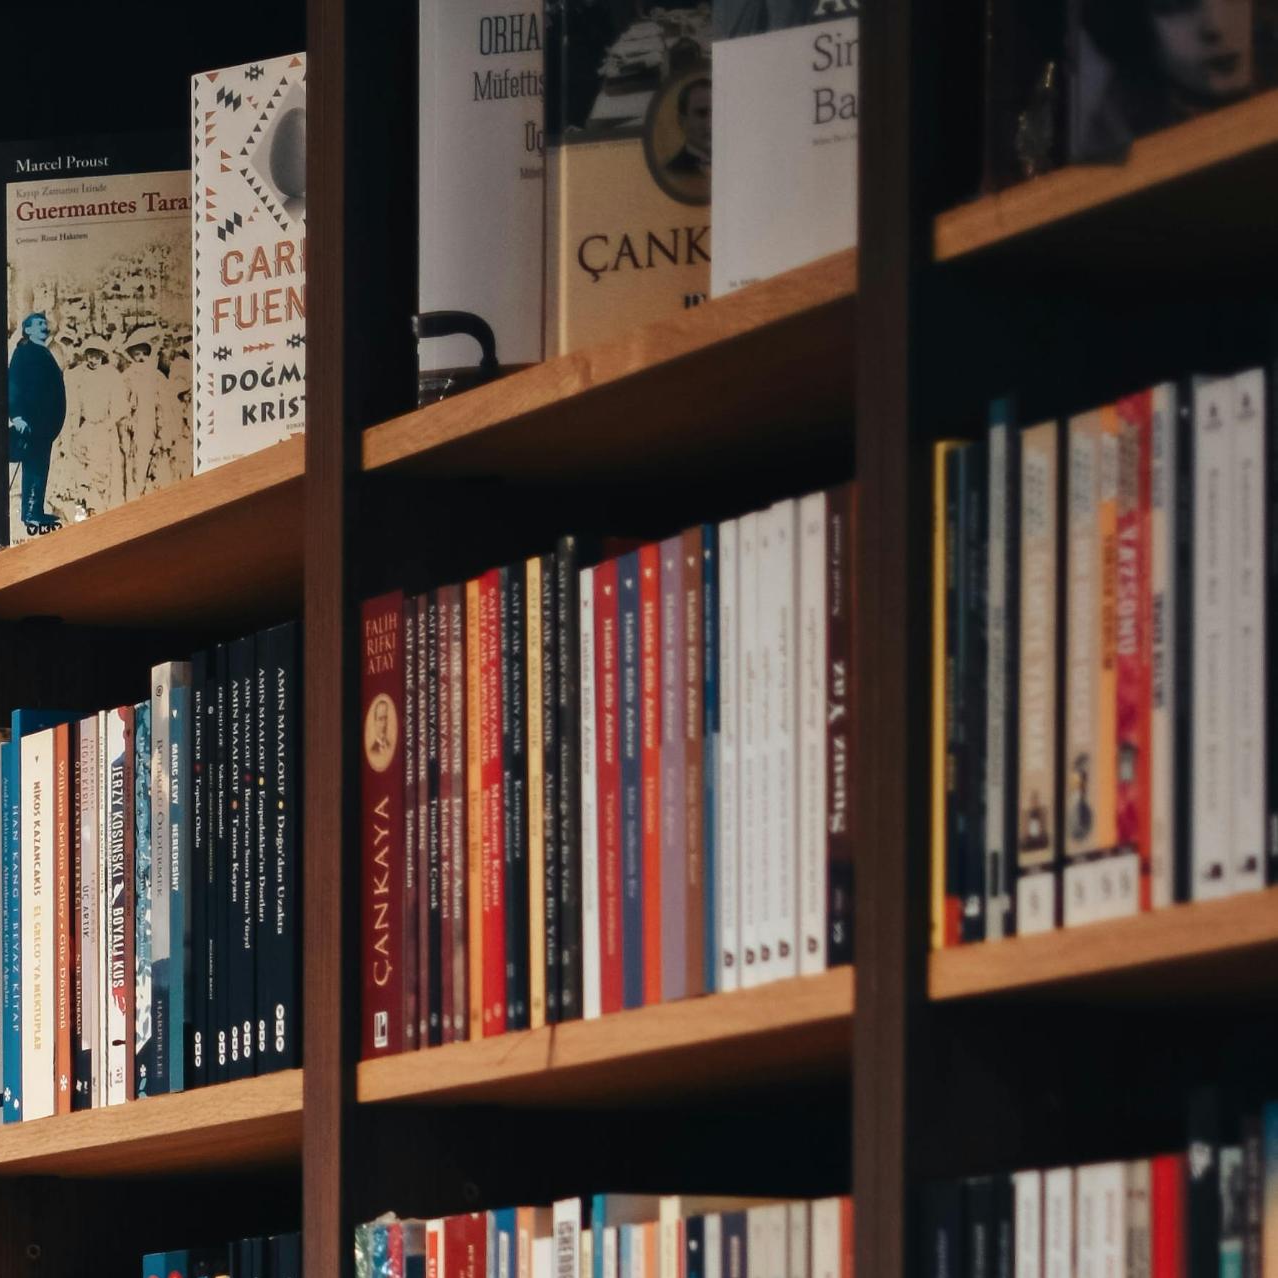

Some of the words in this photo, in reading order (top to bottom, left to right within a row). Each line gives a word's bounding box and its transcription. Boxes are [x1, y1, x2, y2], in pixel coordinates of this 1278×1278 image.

[16, 158, 62, 173] Marcel
[66, 156, 109, 170] Proust
[16, 199, 137, 222] Guermantes
[221, 361, 306, 395] DOĞM
[604, 619, 614, 666] Halide
[604, 673, 614, 708] Edib
[112, 766, 125, 806] JERZY
[373, 796, 392, 986] ÇANKAYA
